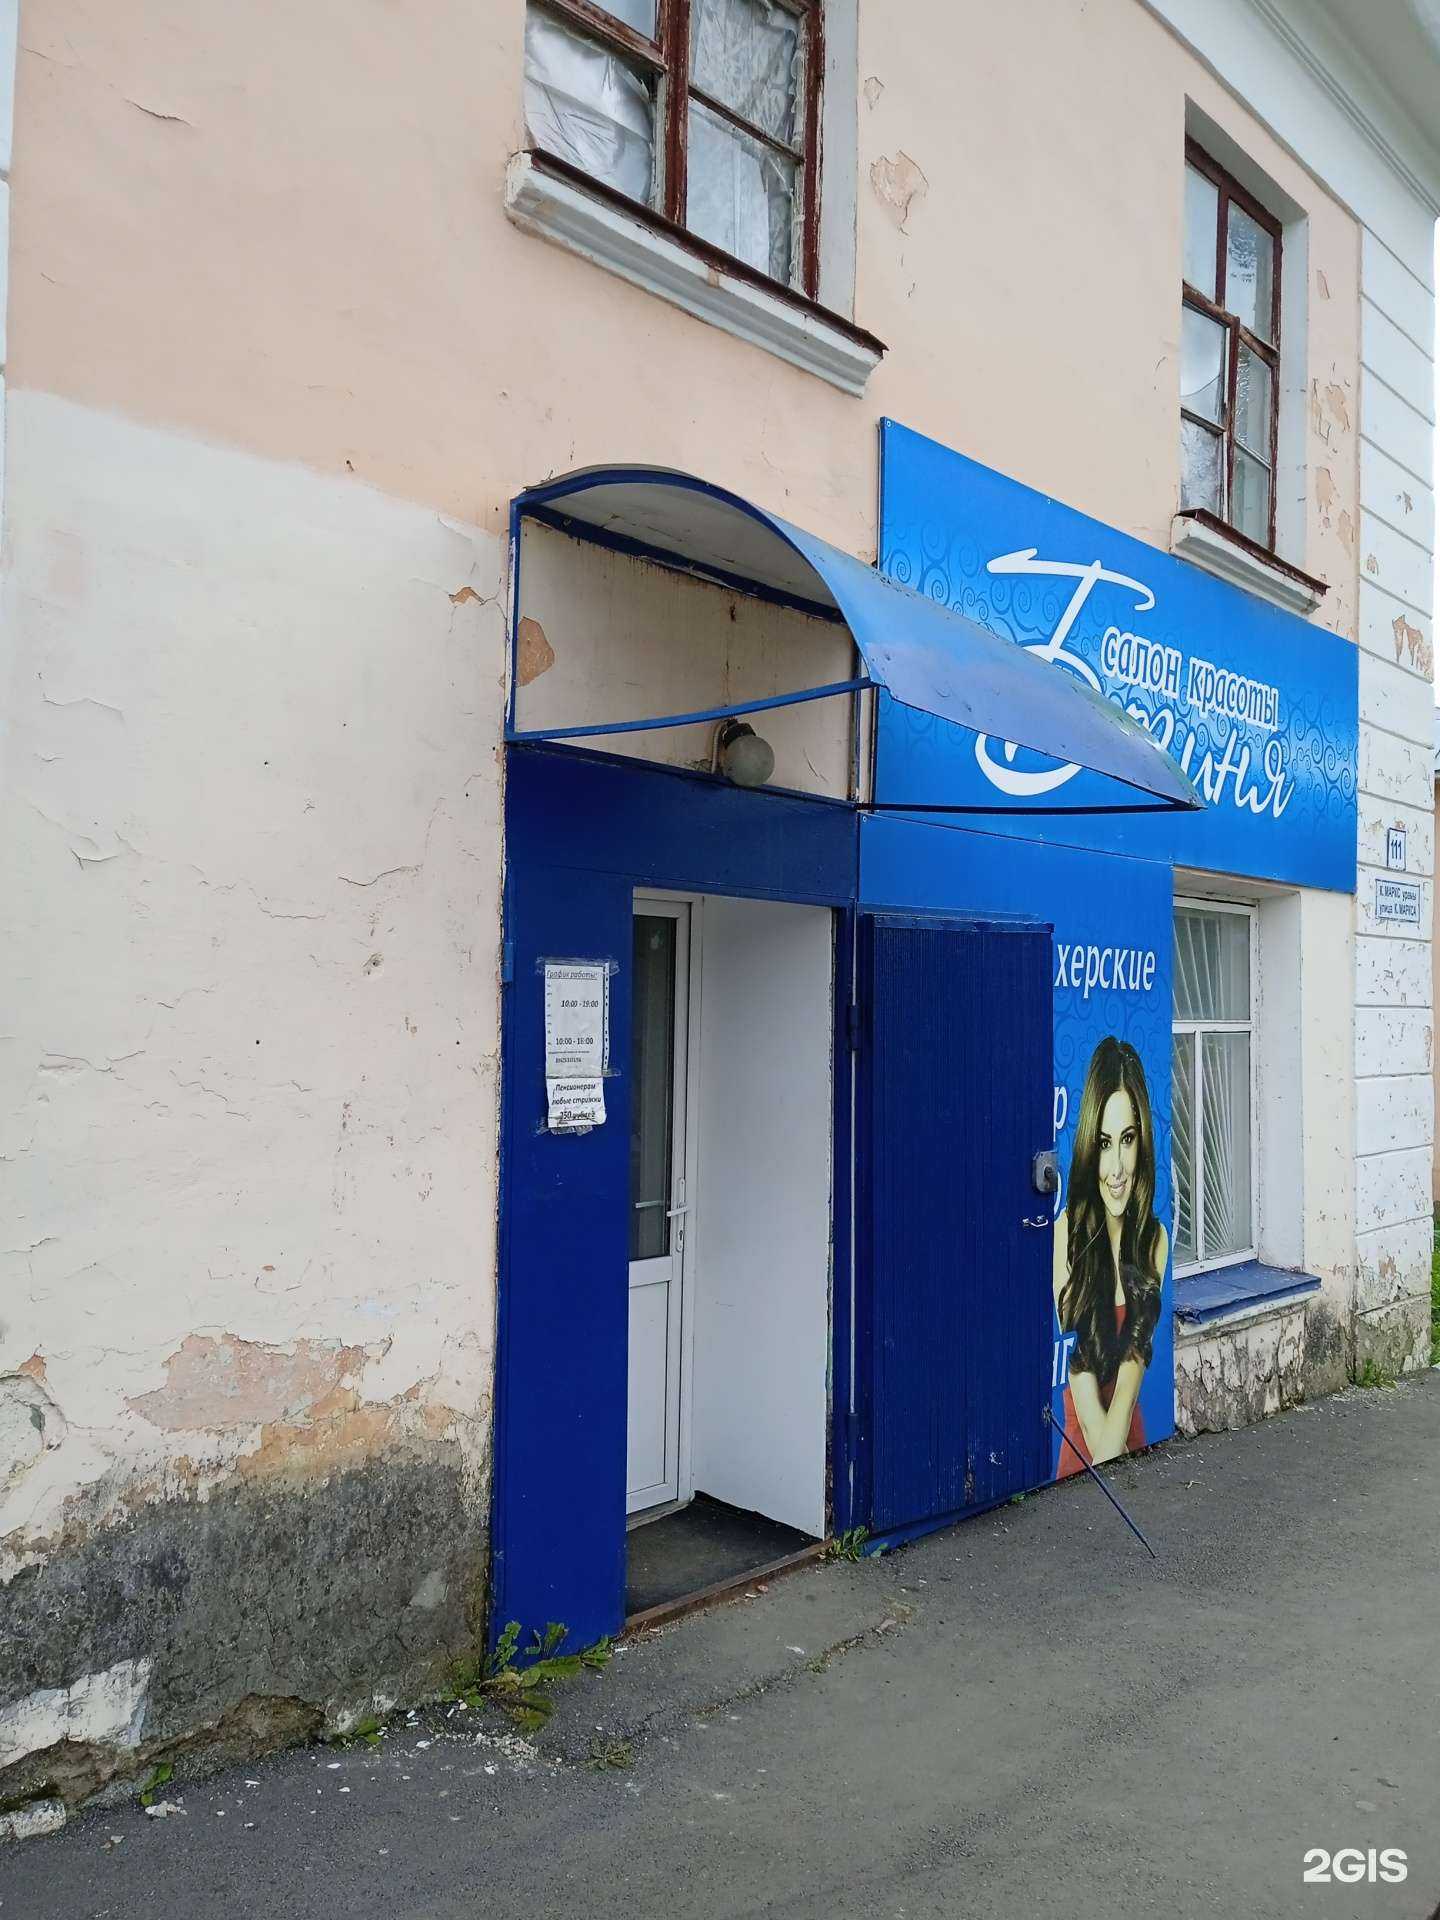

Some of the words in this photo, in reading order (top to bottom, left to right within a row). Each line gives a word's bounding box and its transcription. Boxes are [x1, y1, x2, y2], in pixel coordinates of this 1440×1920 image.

[1101, 626, 1182, 699] салон
[1187, 656, 1279, 732] красоты
[1390, 840, 1402, 860] 111
